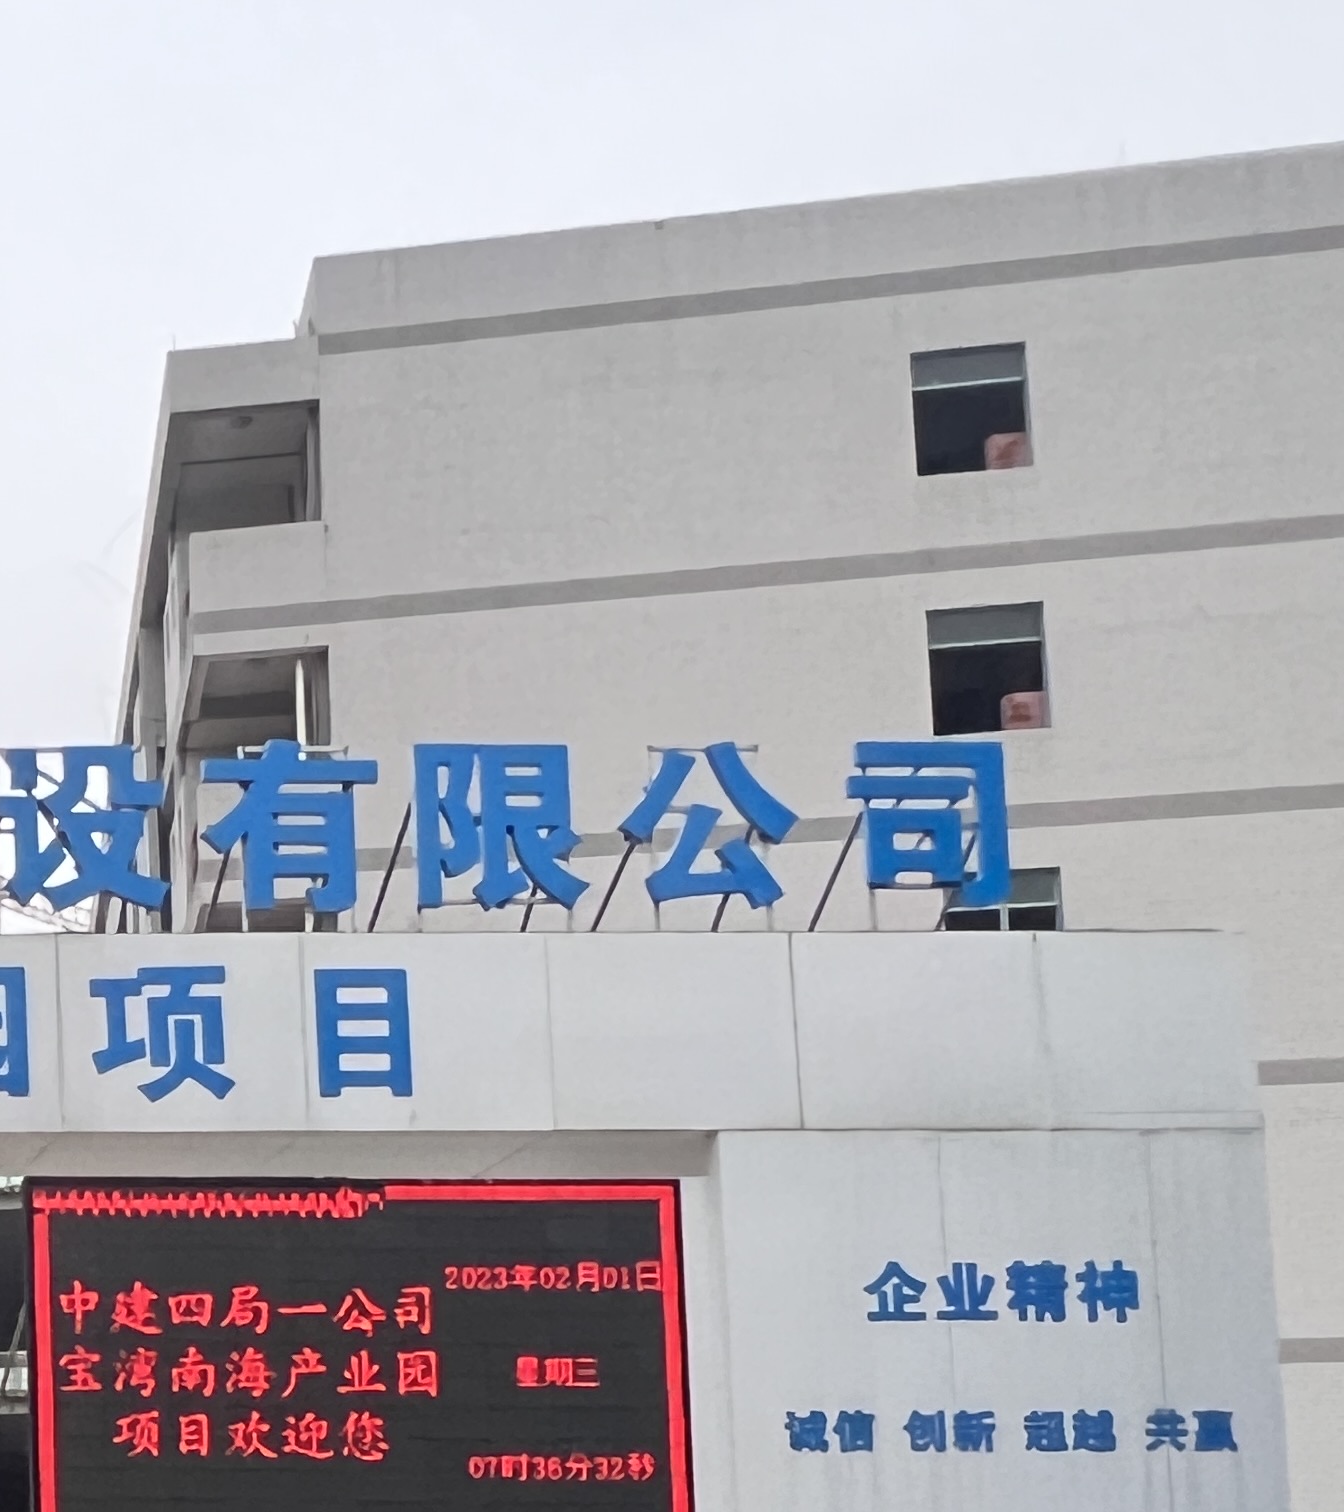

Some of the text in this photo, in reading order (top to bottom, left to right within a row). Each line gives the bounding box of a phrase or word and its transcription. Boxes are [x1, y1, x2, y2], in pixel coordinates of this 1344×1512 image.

[444, 1261, 662, 1292] 2023年02月01日
[863, 1259, 1140, 1323] 企业精神
[57, 1279, 434, 1337] 中建四局一公司
[57, 1346, 441, 1399] 宝湾南海产业园
[516, 1356, 601, 1388] 星期三
[112, 1410, 392, 1462] 项目欢迎您
[467, 1452, 656, 1482] 07时36分32秒
